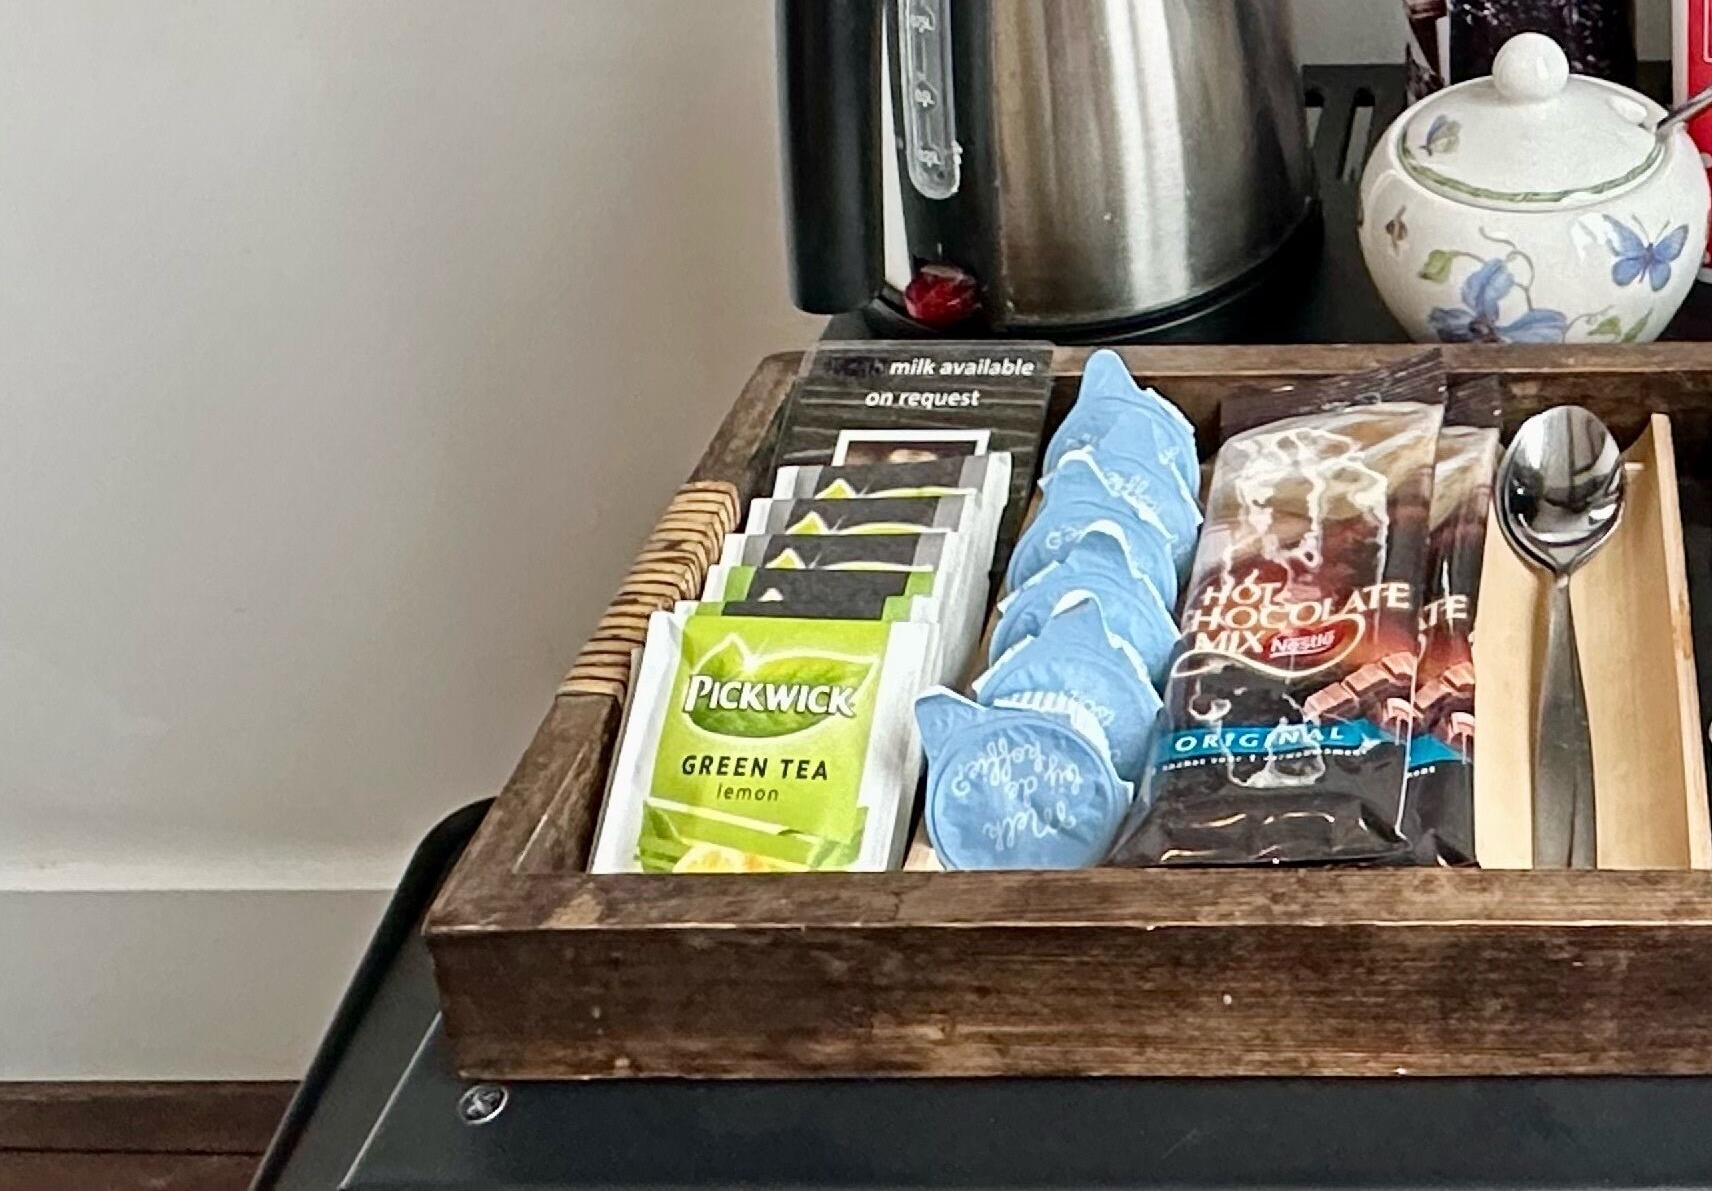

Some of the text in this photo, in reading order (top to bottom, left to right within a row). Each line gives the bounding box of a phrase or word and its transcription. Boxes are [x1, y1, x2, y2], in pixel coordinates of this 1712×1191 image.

[889, 357, 936, 376] milk
[939, 357, 1036, 377] available
[864, 389, 981, 410] on request
[1202, 580, 1284, 607] HOT
[1194, 631, 1266, 654] MIX
[1174, 725, 1345, 752] ORIGINAL
[682, 754, 828, 781] GREEN TEA
[716, 782, 780, 802] lemon
